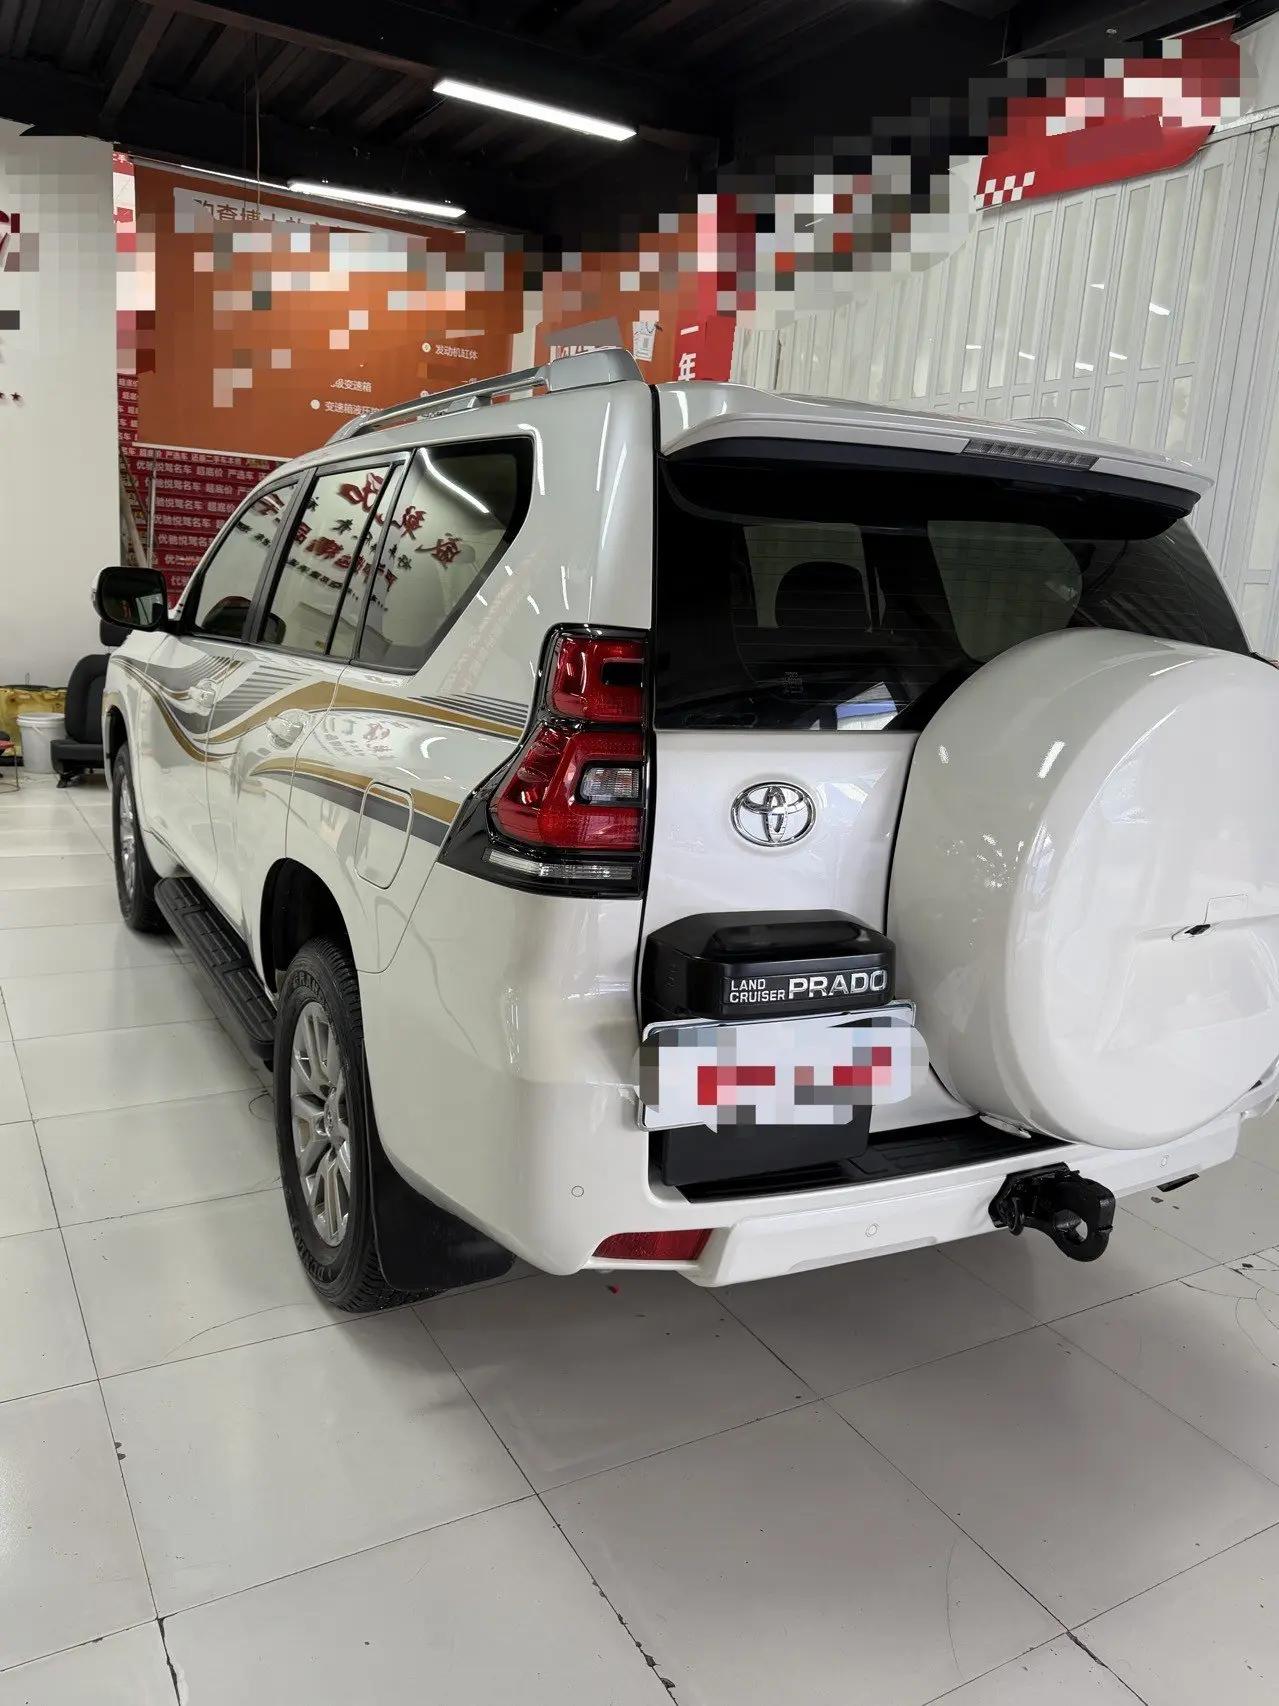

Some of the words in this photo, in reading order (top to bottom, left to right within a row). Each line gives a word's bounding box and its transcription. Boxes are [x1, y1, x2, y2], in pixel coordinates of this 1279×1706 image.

[435, 344, 479, 360] 发动机缸体
[730, 978, 766, 991] LAND
[788, 969, 888, 1000] PRADO
[729, 989, 786, 1003] CRUISER
